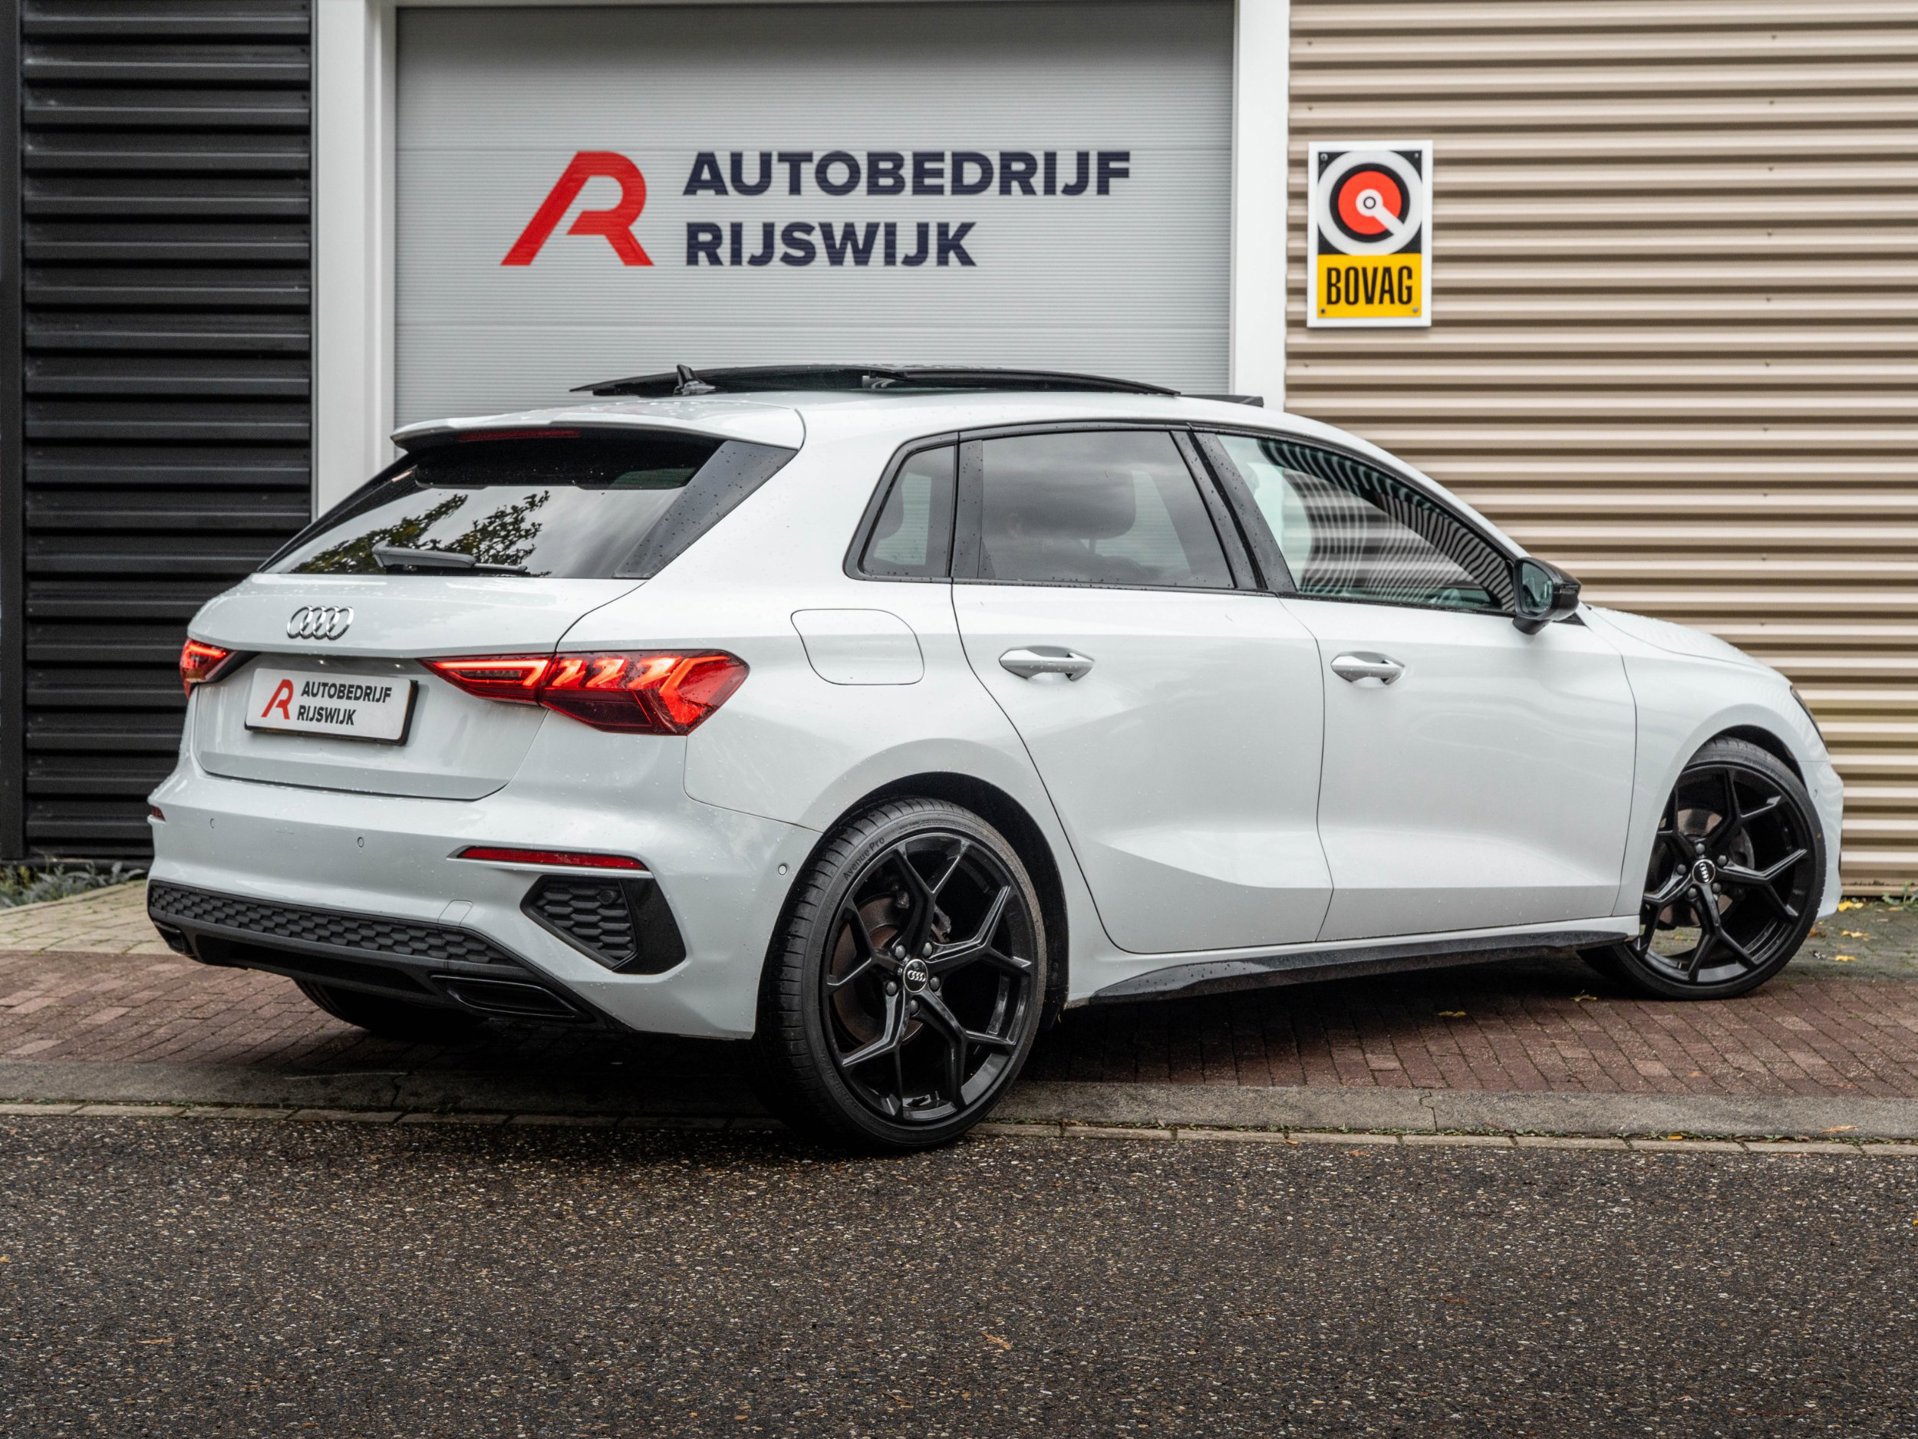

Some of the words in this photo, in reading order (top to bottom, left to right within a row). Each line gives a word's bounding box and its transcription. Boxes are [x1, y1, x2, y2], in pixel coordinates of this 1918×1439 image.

[682, 150, 1131, 196] AUTOBEDRIJF
[685, 221, 978, 267] RIJSWIJK
[1326, 265, 1413, 306] BOVAG
[301, 681, 392, 703] AUTOBEDRIJF
[297, 705, 356, 725] RIJSWIJK
[843, 848, 870, 881] Avenue
[868, 836, 886, 851] Pro
